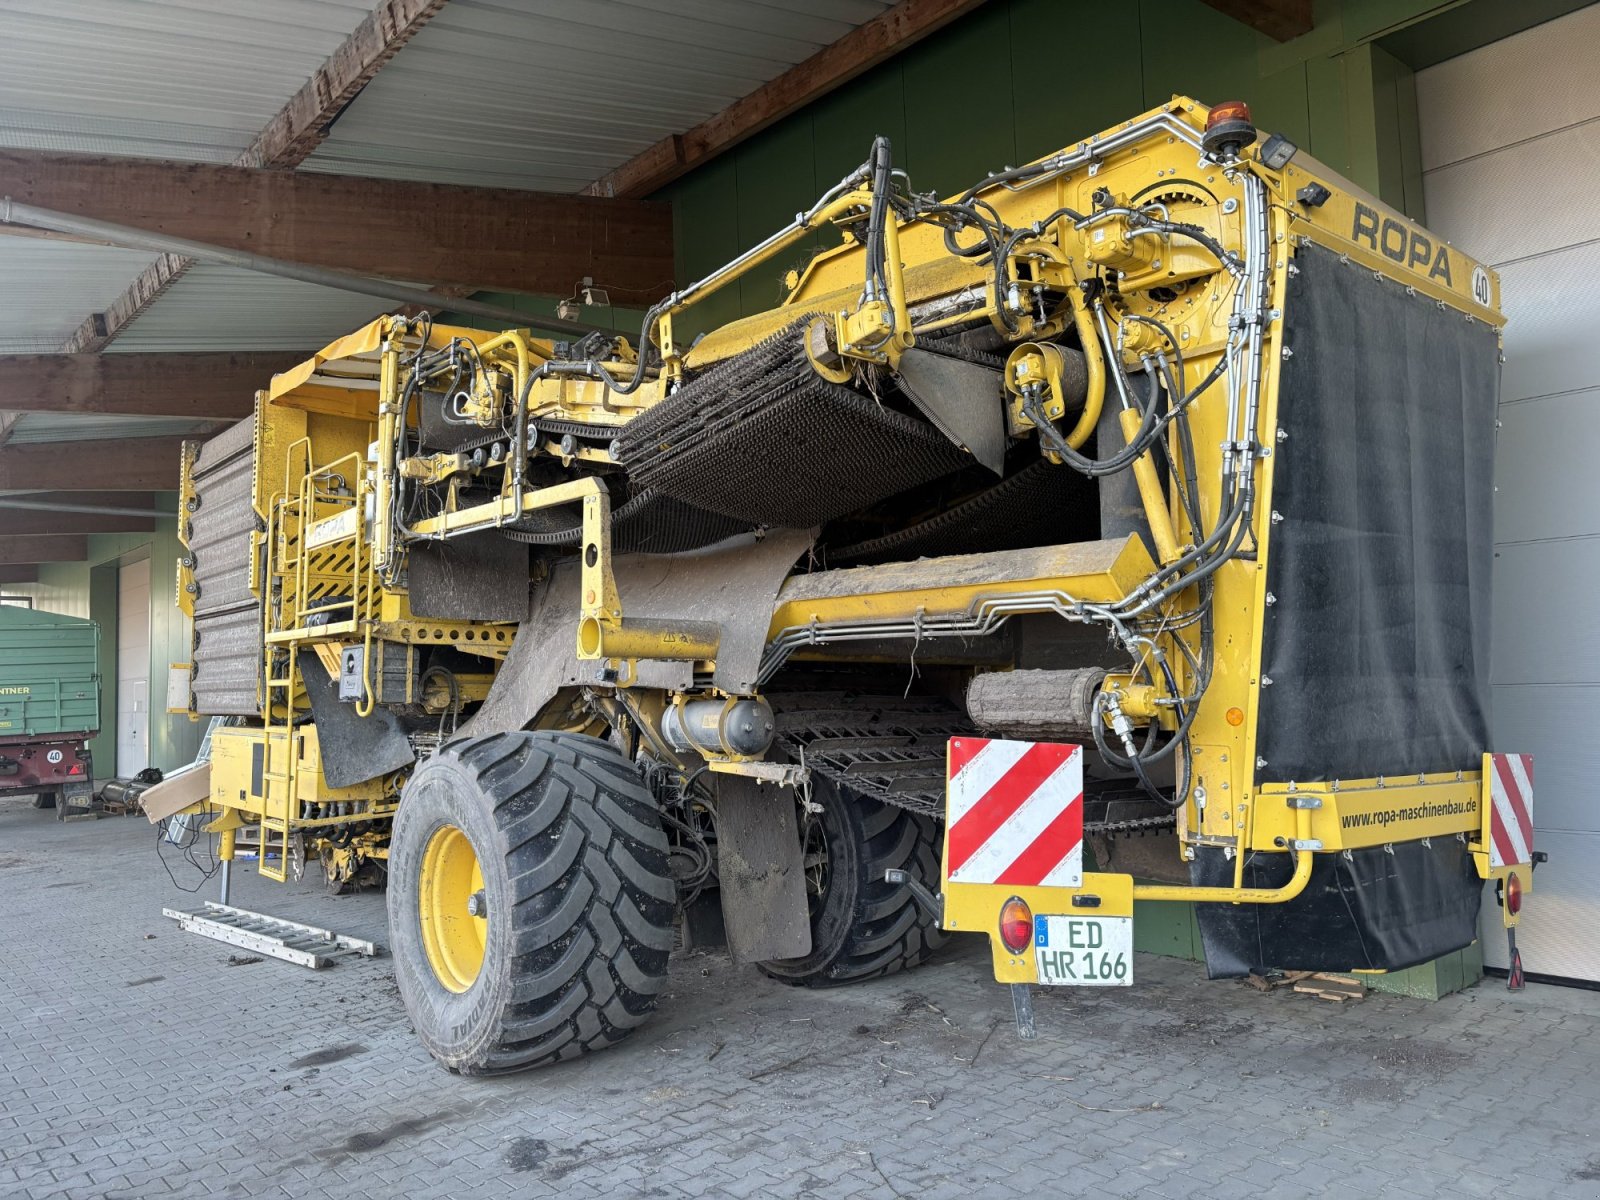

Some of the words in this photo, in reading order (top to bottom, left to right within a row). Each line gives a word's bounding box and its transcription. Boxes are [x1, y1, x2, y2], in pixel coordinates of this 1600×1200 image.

[1352, 201, 1453, 288] ROPA
[1475, 272, 1488, 305] 40
[1342, 797, 1477, 829] www.ropa-maschinenbau.de
[1038, 935, 1045, 943] D
[1068, 921, 1103, 949] ED
[1041, 950, 1077, 979] HR
[1082, 951, 1127, 980] 166
